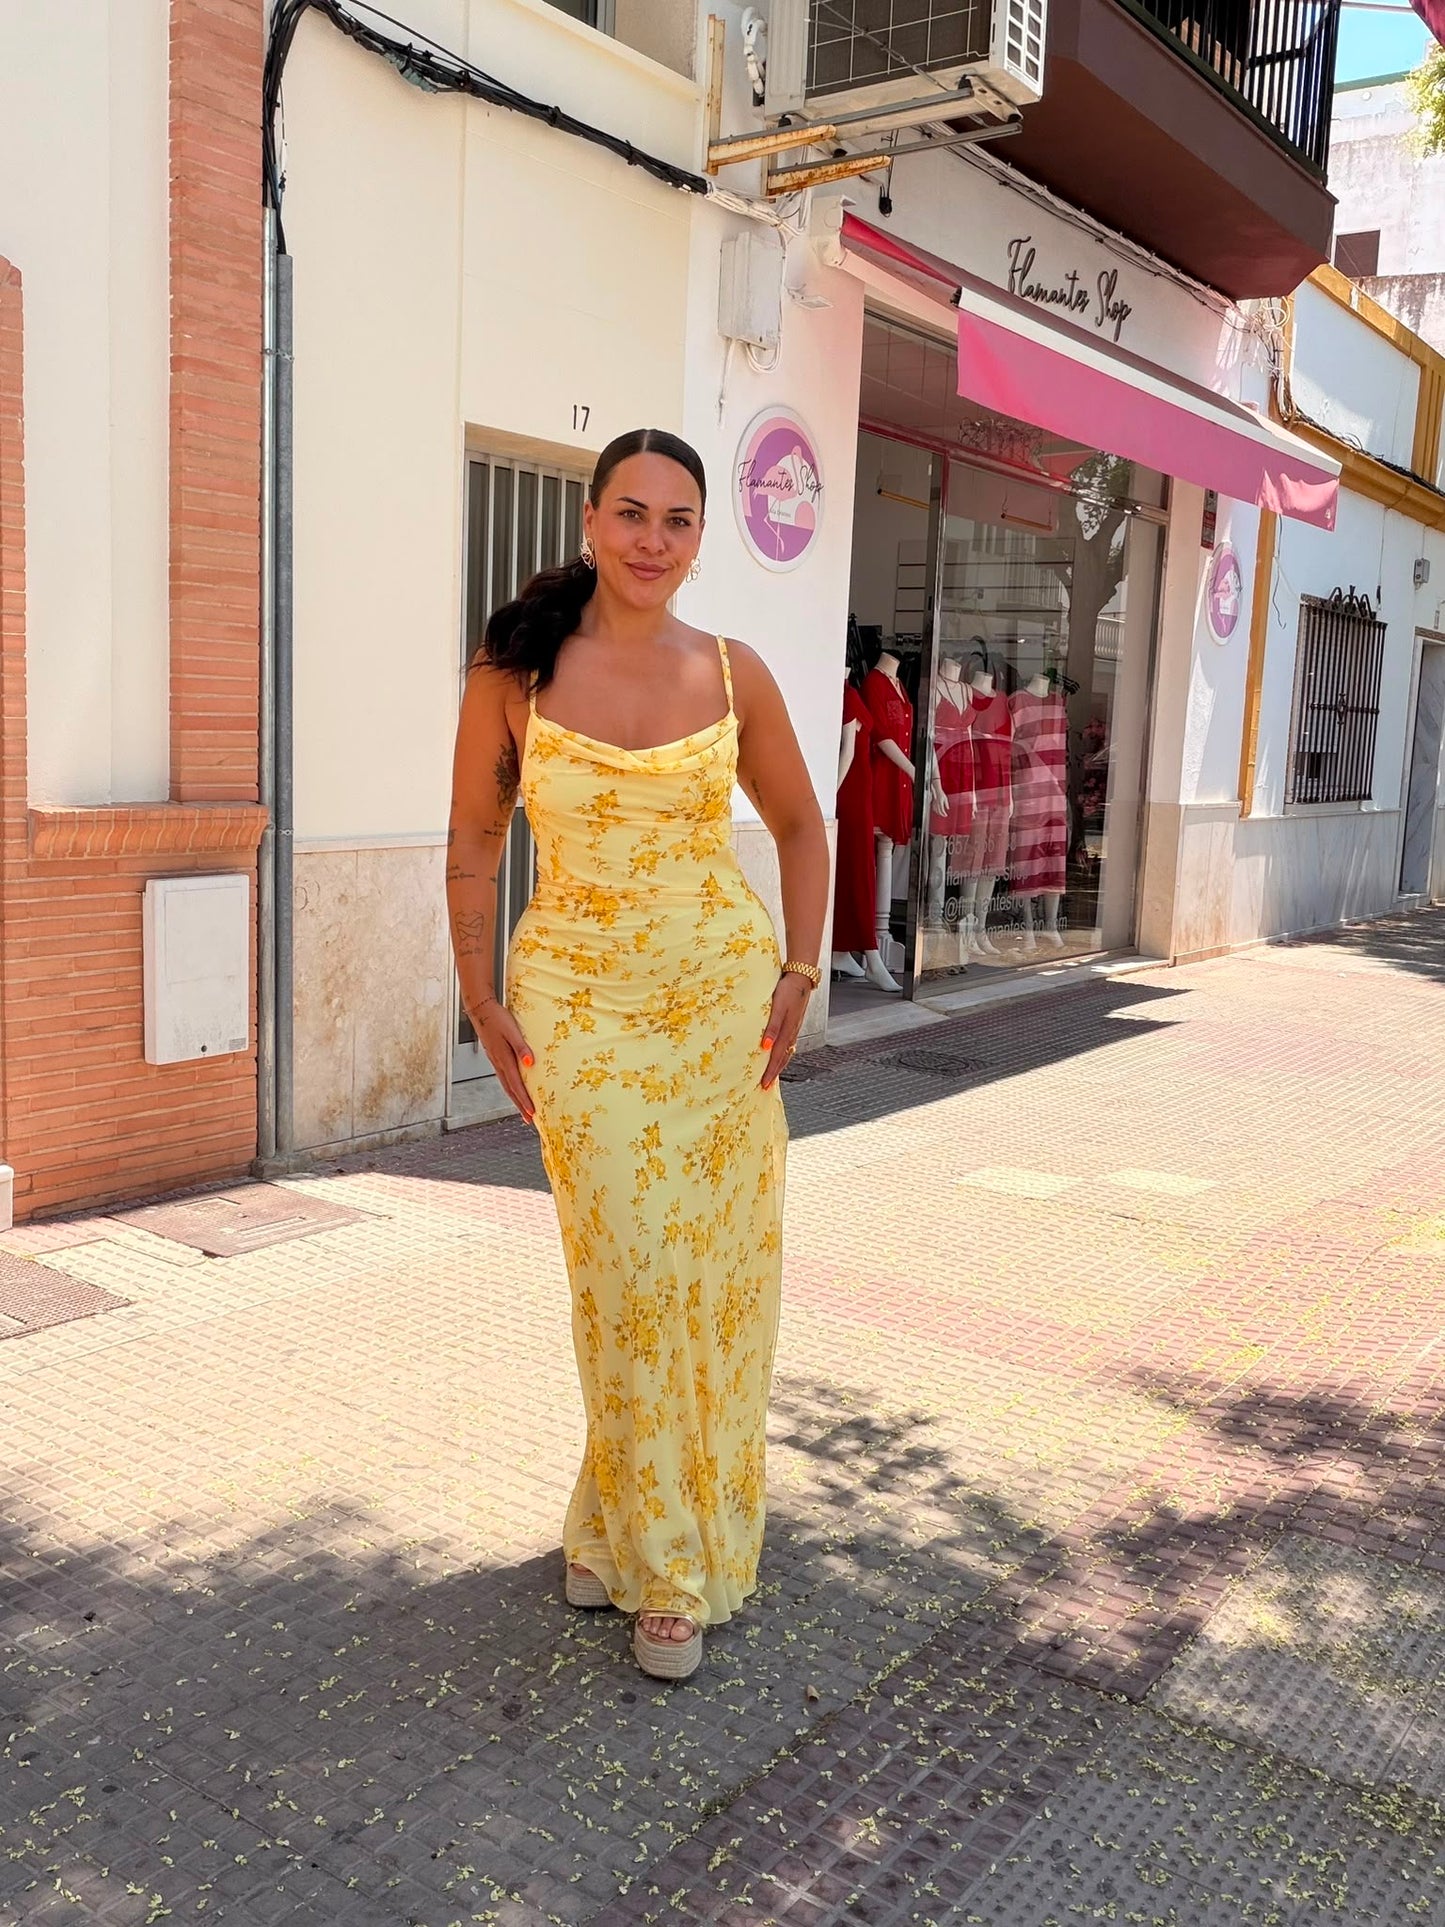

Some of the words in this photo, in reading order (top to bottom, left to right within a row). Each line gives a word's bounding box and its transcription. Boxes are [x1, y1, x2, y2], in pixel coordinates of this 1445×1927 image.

[1007, 236, 1090, 313] Flamantes
[1095, 269, 1132, 342] Shop
[573, 404, 590, 432] 17
[738, 459, 795, 492] Flamantes
[798, 463, 824, 503] Shop
